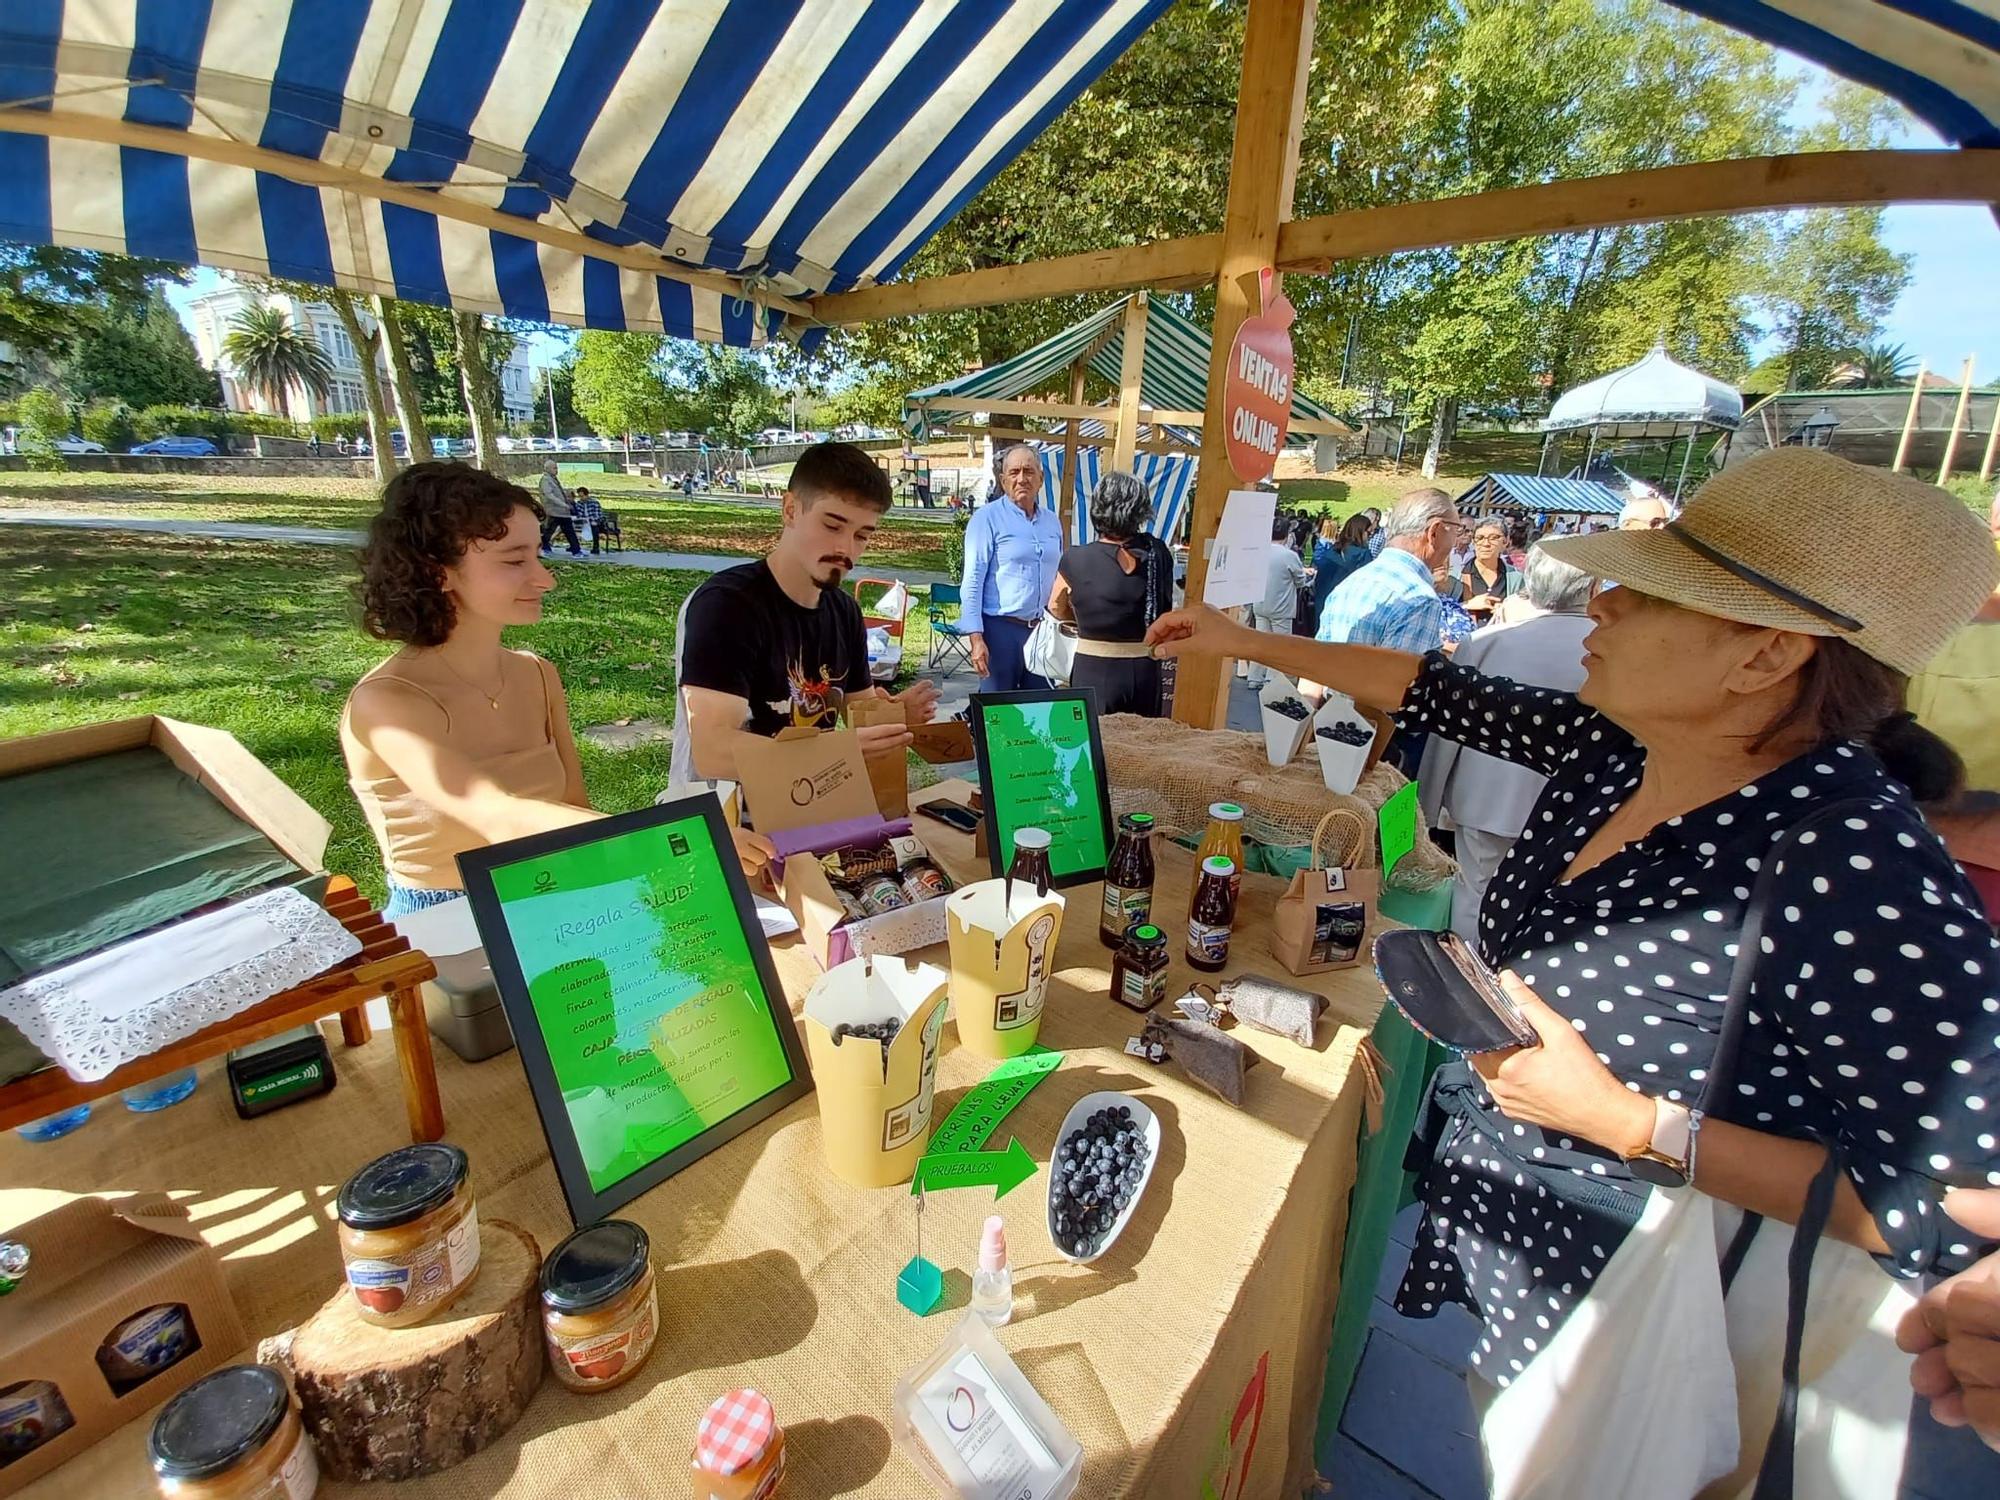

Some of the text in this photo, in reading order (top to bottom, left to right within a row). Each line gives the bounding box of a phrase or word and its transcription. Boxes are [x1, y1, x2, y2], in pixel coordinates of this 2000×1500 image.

[1239, 342, 1288, 405] VENTAS
[1232, 406, 1279, 455] ONLINE
[553, 883, 696, 943] ¡Regala SALUD!
[554, 944, 620, 974] Mermeladas
[560, 966, 618, 994] elaborados
[620, 959, 639, 971] con
[684, 929, 718, 948] nuestra
[603, 971, 660, 999] totalmente
[664, 953, 707, 976] naturales
[710, 946, 724, 958] sin
[572, 1006, 632, 1034] colorantes,
[674, 1004, 691, 1017] DE
[692, 983, 735, 1009] REGALO
[616, 1012, 719, 1067] PERSONALIZADAS
[620, 1058, 677, 1092] mermeladas
[712, 1035, 728, 1047] con
[624, 1081, 671, 1113] productos
[929, 1098, 984, 1155] TARRINAS
[981, 1080, 1000, 1095] DE
[958, 1115, 993, 1152] PARA
[992, 1080, 1029, 1111] LLEVAR
